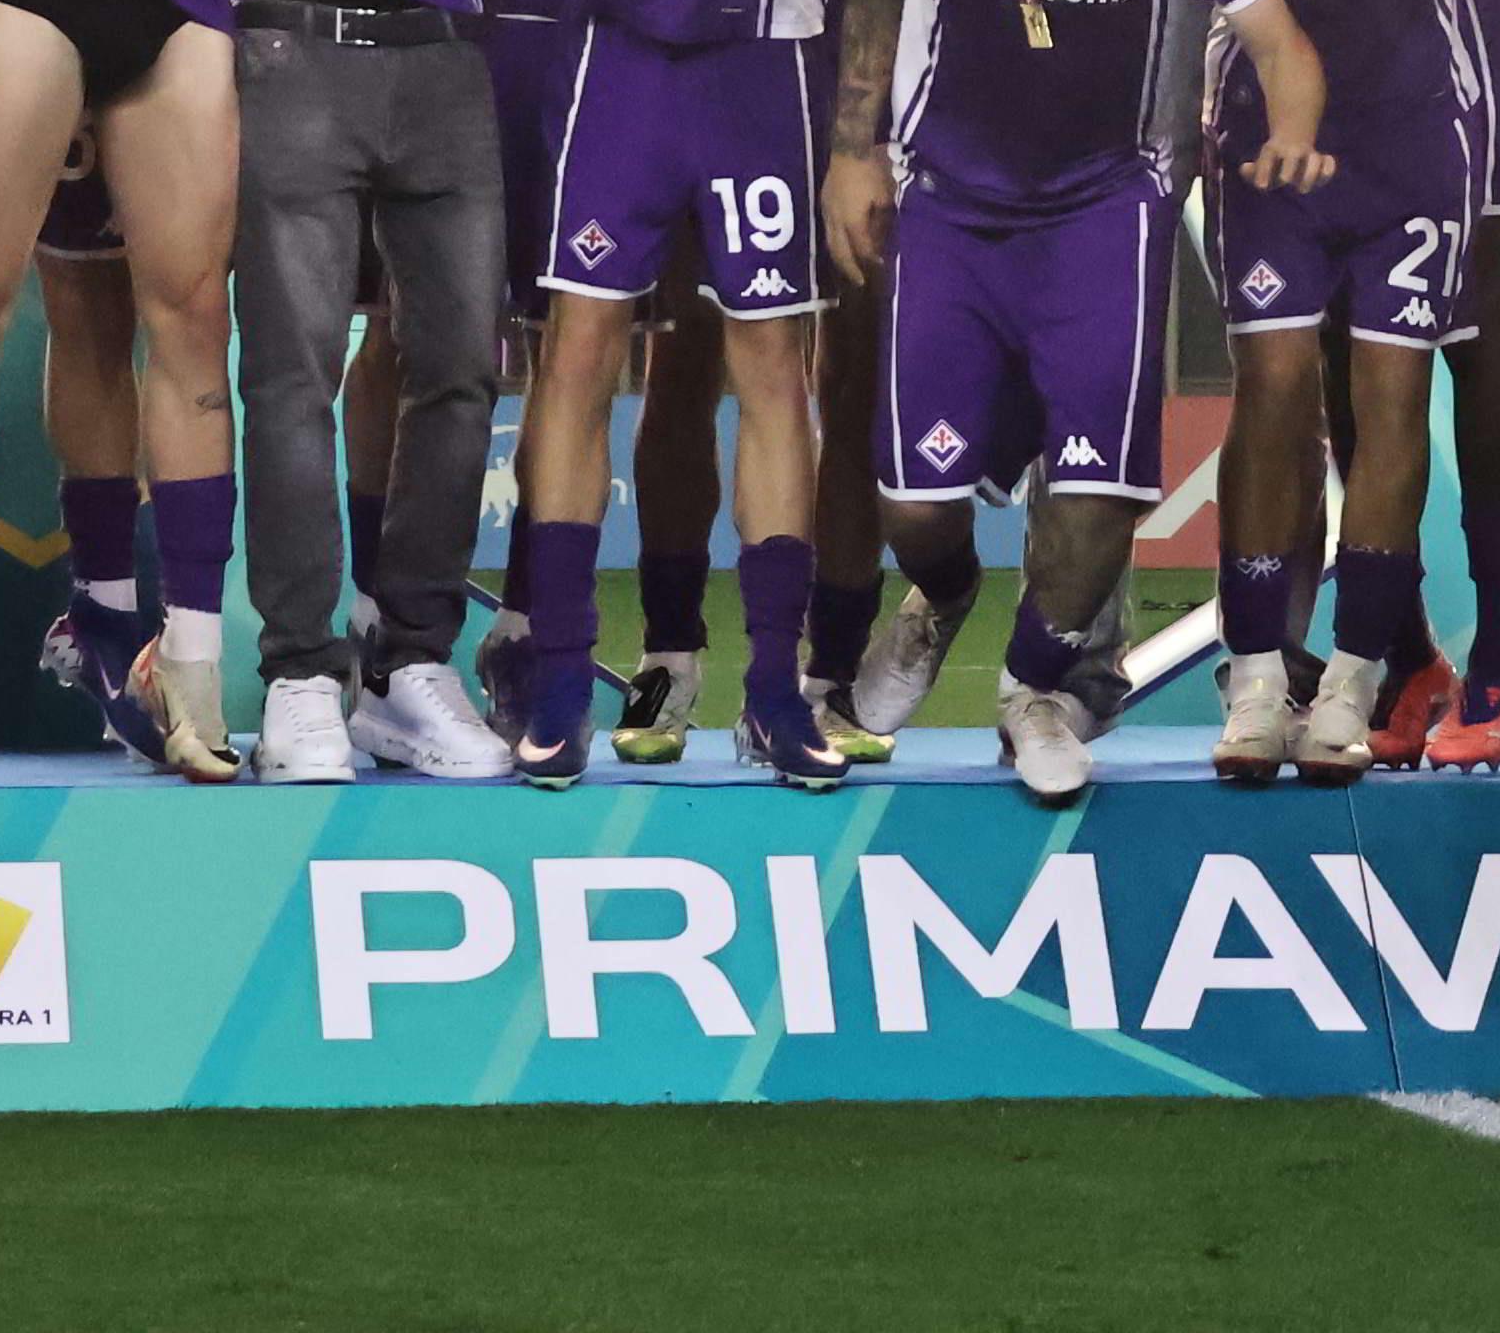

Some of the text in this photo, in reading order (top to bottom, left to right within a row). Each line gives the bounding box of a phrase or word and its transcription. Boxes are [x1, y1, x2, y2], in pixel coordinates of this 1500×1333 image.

[711, 175, 796, 253] 19
[1387, 216, 1461, 297] 21
[43, 1009, 51, 1025] 1
